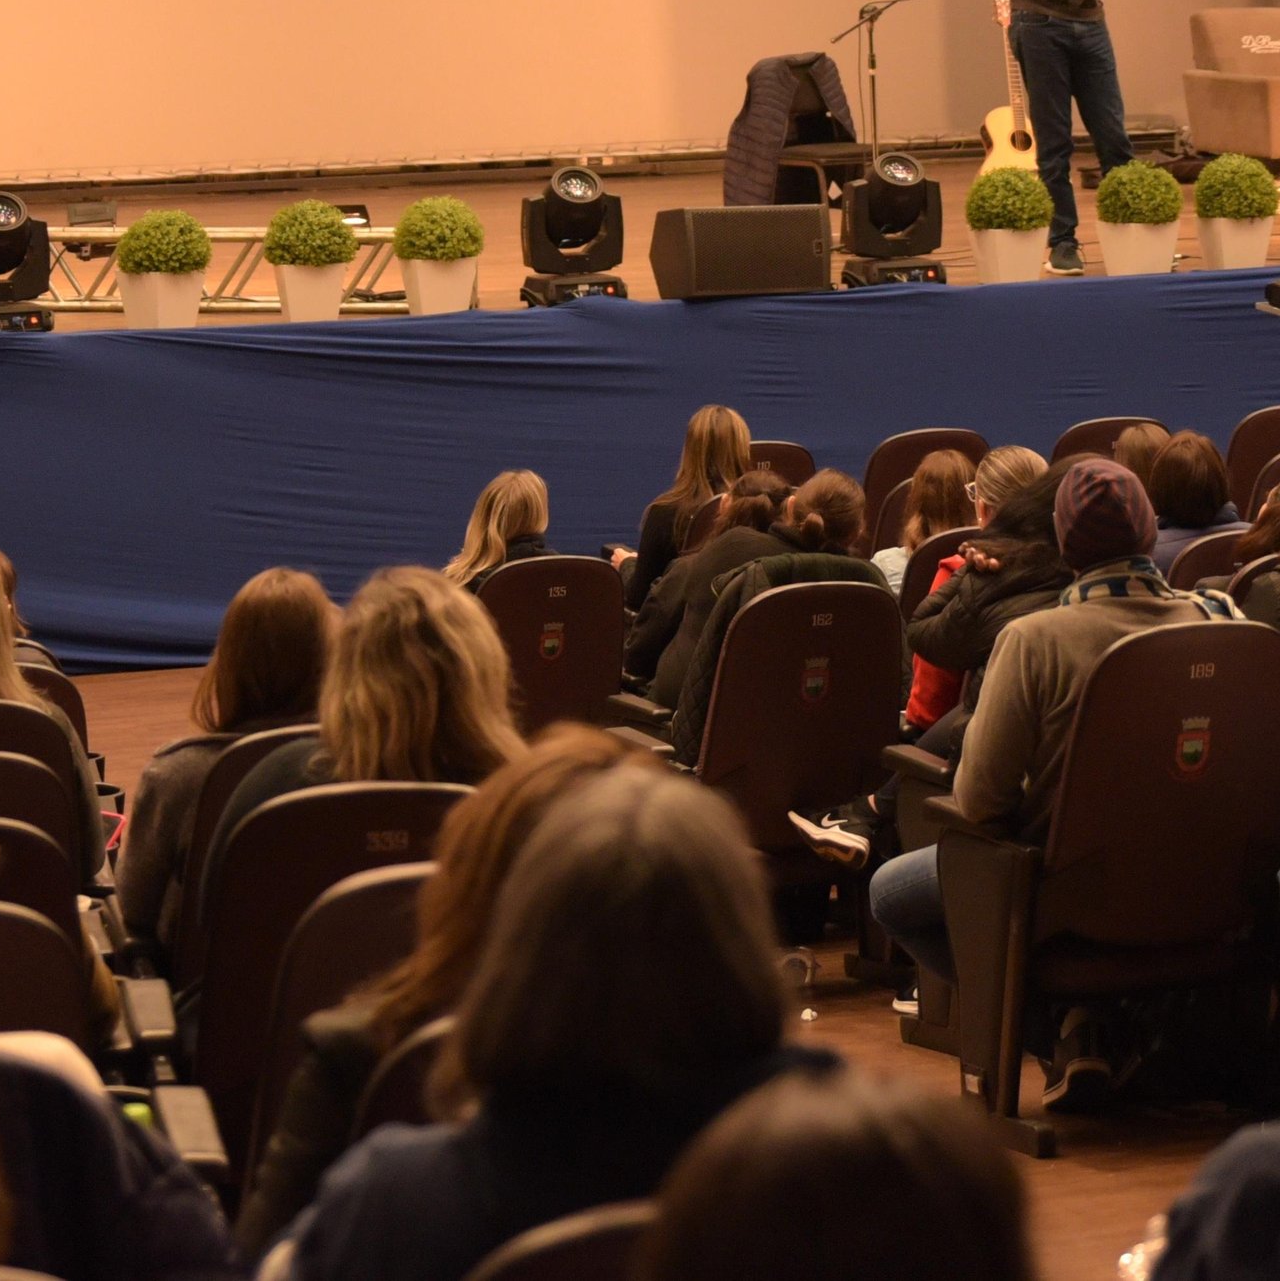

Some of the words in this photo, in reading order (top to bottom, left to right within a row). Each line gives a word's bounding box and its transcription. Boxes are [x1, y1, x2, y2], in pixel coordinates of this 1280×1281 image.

[548, 586, 568, 598] 135
[811, 613, 833, 627] 162
[1190, 662, 1215, 680] 189
